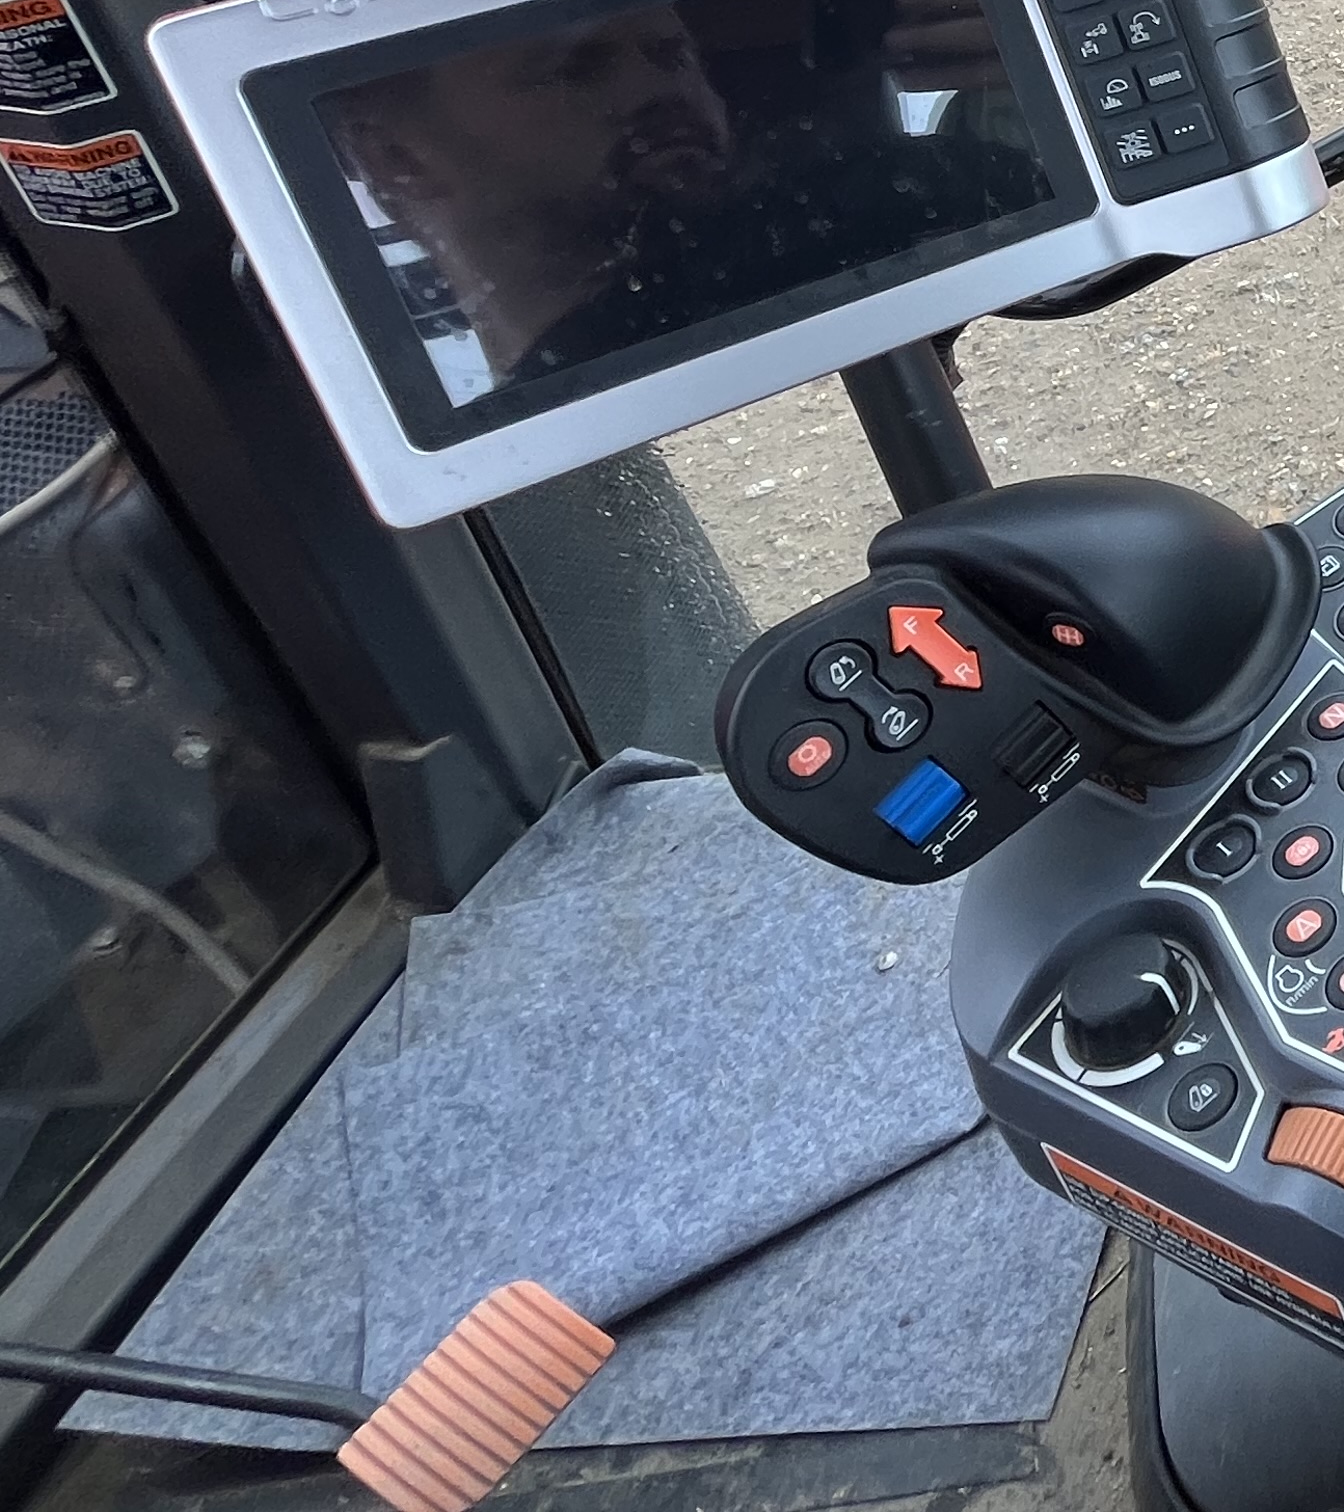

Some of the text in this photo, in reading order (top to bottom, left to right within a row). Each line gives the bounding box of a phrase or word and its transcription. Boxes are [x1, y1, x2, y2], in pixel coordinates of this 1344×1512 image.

[903, 616, 918, 635] F
[954, 662, 974, 681] R
[1294, 917, 1317, 937] A
